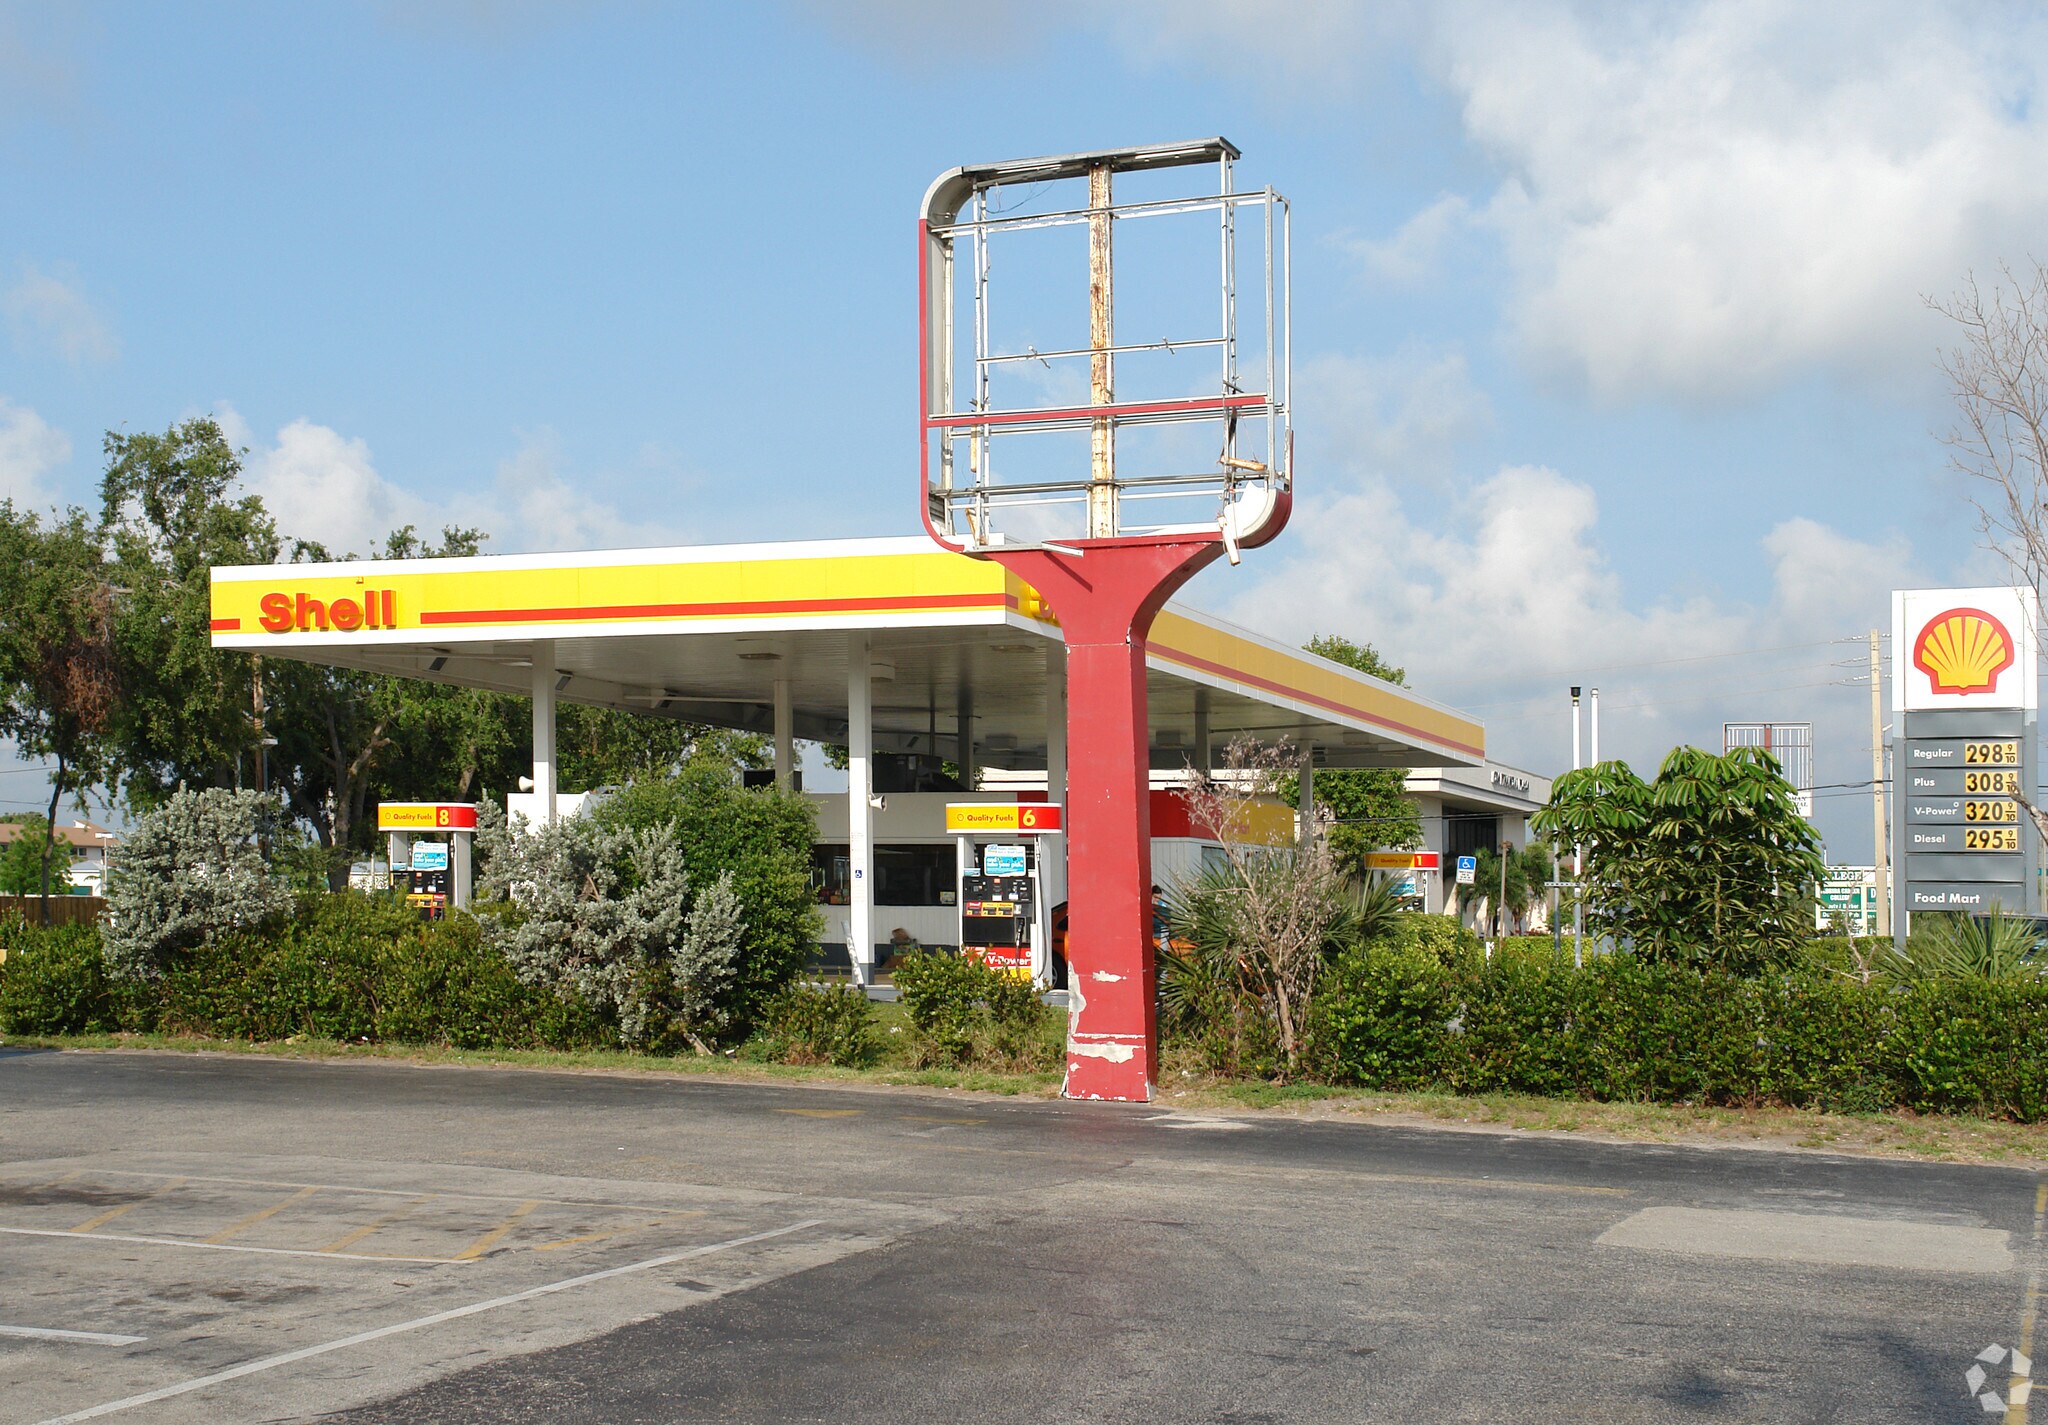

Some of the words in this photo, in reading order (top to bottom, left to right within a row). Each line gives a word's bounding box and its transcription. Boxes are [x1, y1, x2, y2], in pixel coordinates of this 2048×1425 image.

[259, 590, 396, 632] Shell
[1914, 749, 1953, 759] Regular
[1966, 744, 2003, 763] 298
[1914, 778, 1935, 786] Plus
[1966, 773, 2003, 792] 308
[393, 813, 415, 821] Quality
[440, 810, 449, 825] 8
[967, 814, 993, 822] Quality
[1022, 810, 1036, 826] 6
[1914, 807, 1957, 815] V-Power
[1966, 802, 2003, 821] 320
[1914, 834, 1946, 843] Diesel
[1966, 830, 2003, 849] 295
[1416, 856, 1422, 866] 1
[1914, 892, 1945, 904] Food
[1949, 893, 1981, 904] Mart
